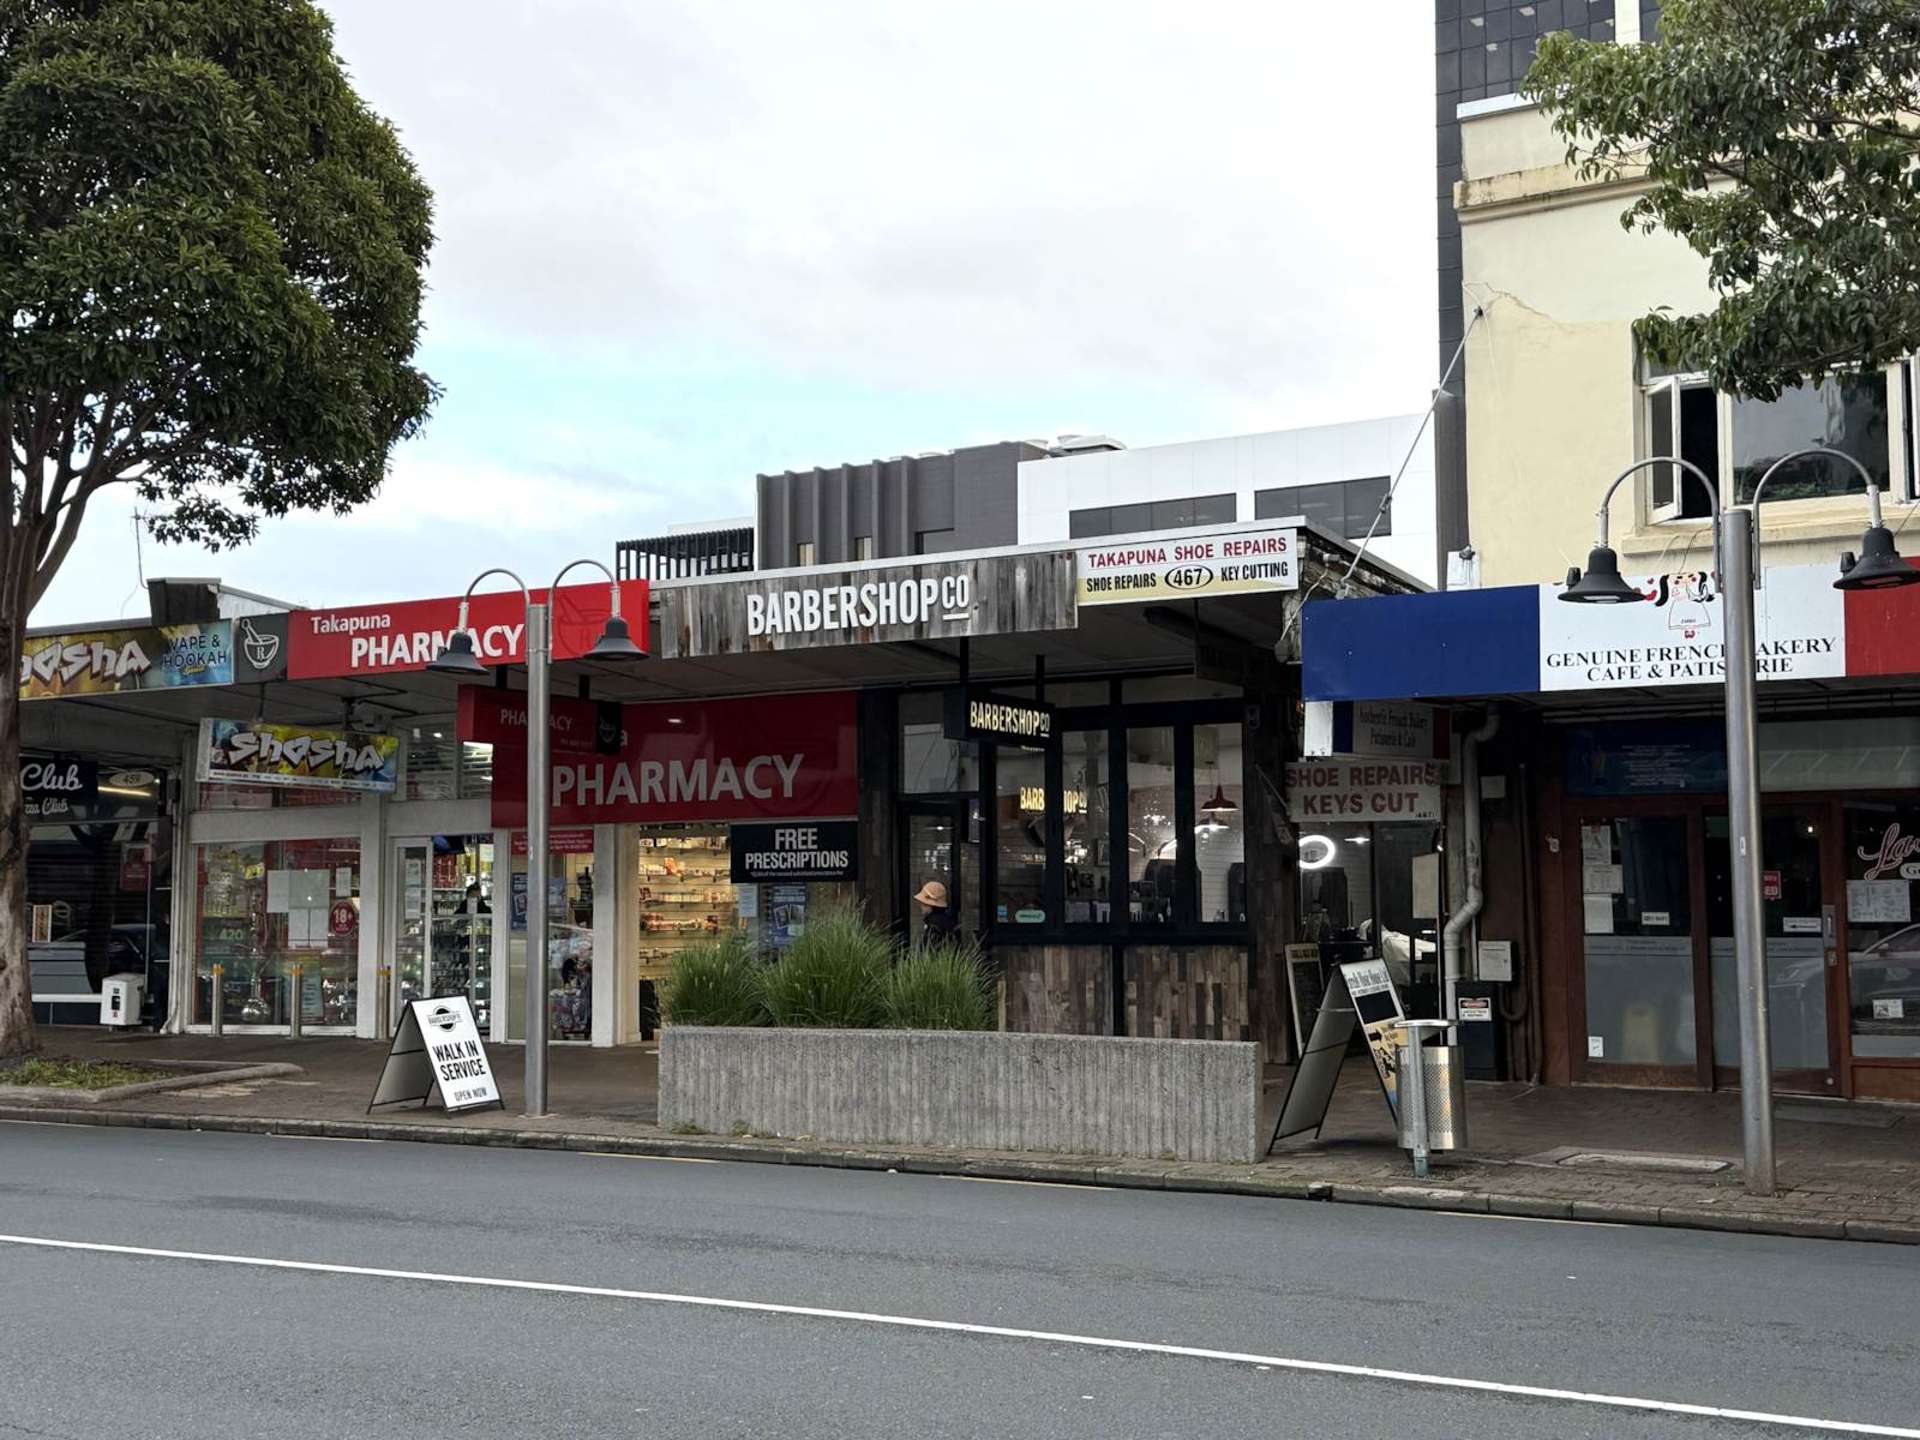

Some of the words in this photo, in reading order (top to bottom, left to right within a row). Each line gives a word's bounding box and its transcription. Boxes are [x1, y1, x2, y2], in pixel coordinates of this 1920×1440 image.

[1089, 548, 1166, 568] TAKAPUNA
[1174, 544, 1214, 561] SHOE
[1223, 537, 1287, 557] REPAIRS
[1086, 577, 1113, 593] SHOE
[1114, 573, 1157, 590] REPAIRS
[1173, 568, 1202, 587] 467
[1221, 565, 1240, 582] KEY
[1242, 562, 1288, 580] CUTTING
[746, 578, 939, 636] BARBERSHOP
[942, 574, 970, 610] CO
[311, 614, 391, 635] Takapuna
[167, 636, 207, 651] VAPE
[211, 634, 220, 648] &
[1546, 647, 1642, 669] GENUINE
[1647, 643, 1725, 663] FRENC
[1753, 637, 1837, 656] AKERY
[163, 649, 227, 667] HOOKAH
[1587, 663, 1642, 683] CAFE
[1647, 663, 1663, 679] &
[1669, 657, 1793, 678] PATISRIE
[970, 701, 1040, 736] BARBERSHOP
[20, 763, 83, 791] Club
[552, 753, 805, 808] PHARMACY
[1287, 767, 1338, 788] SHOE
[1350, 765, 1440, 786] REPAIRS
[1304, 793, 1363, 815] KEYS
[1371, 792, 1420, 813] CUT
[775, 828, 818, 850] FREE
[745, 850, 849, 871] PRESCRIPTIONS
[433, 1042, 467, 1062] WALK
[464, 1040, 479, 1057] IN
[440, 1058, 486, 1081] SERVICE
[454, 1089, 472, 1102] OPEN
